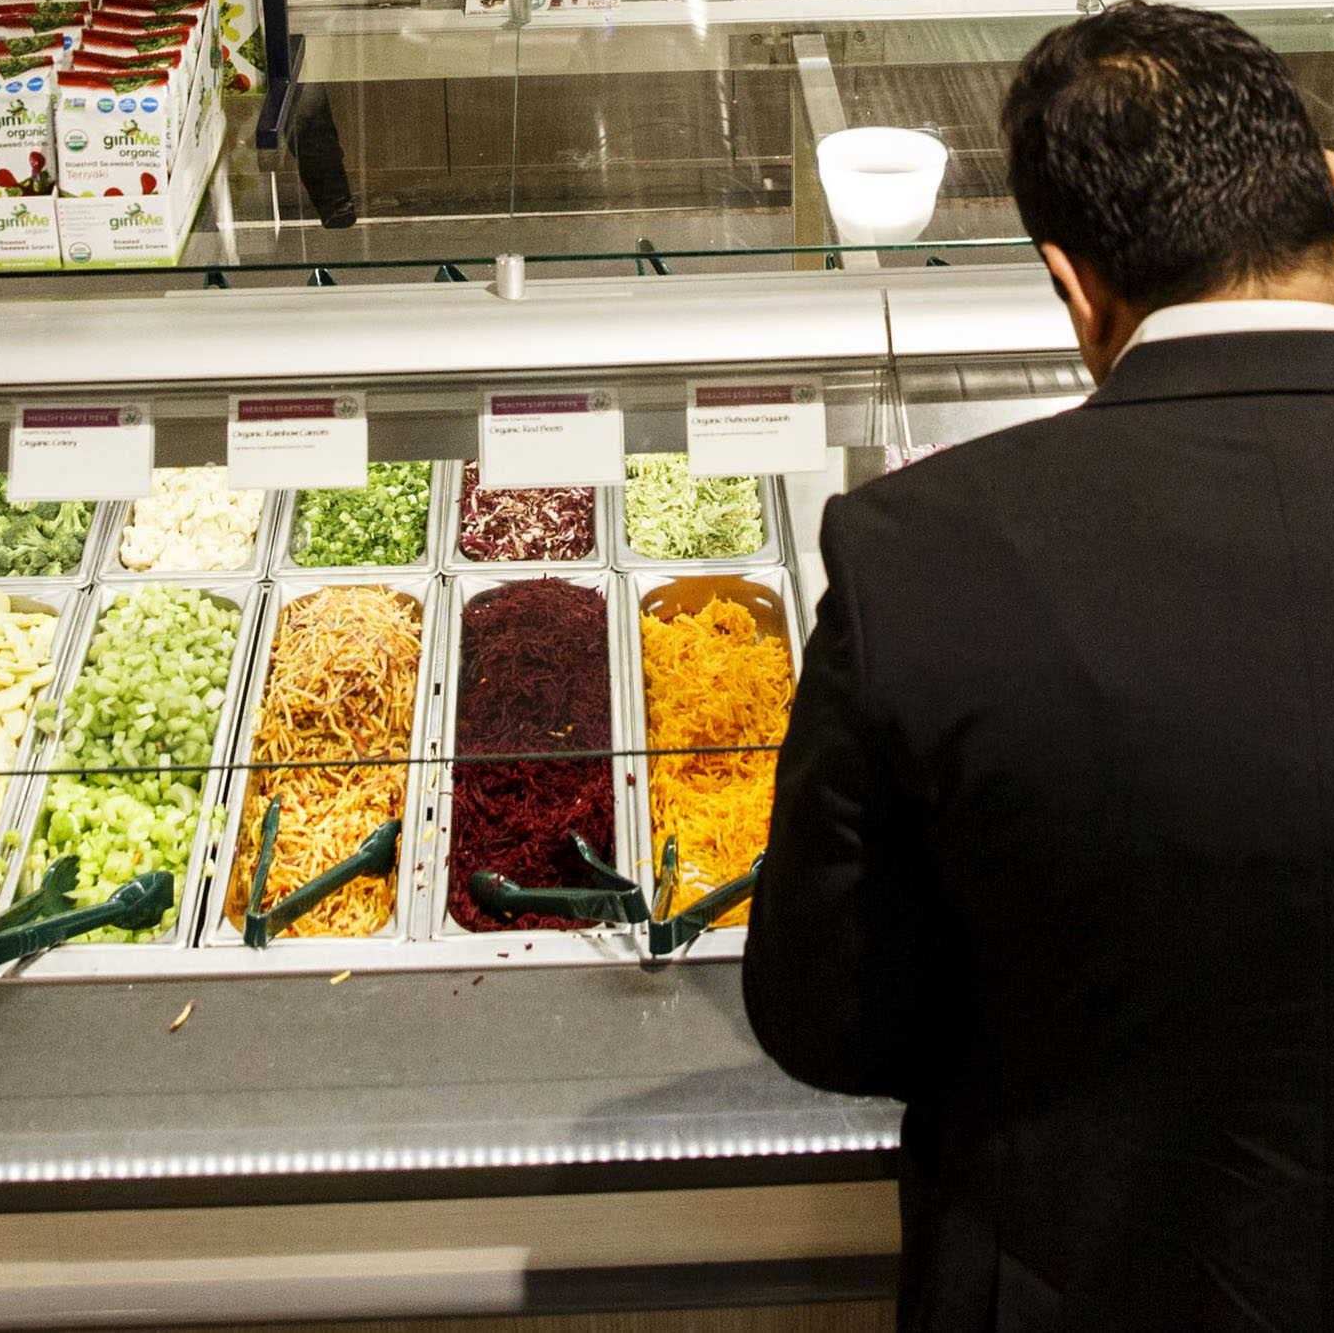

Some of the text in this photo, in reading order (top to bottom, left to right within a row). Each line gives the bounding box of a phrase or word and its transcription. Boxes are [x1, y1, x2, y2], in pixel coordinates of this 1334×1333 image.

[7, 126, 48, 139] organic
[103, 131, 161, 148] gimMe
[119, 147, 161, 160] organic
[109, 214, 164, 231] gimMe
